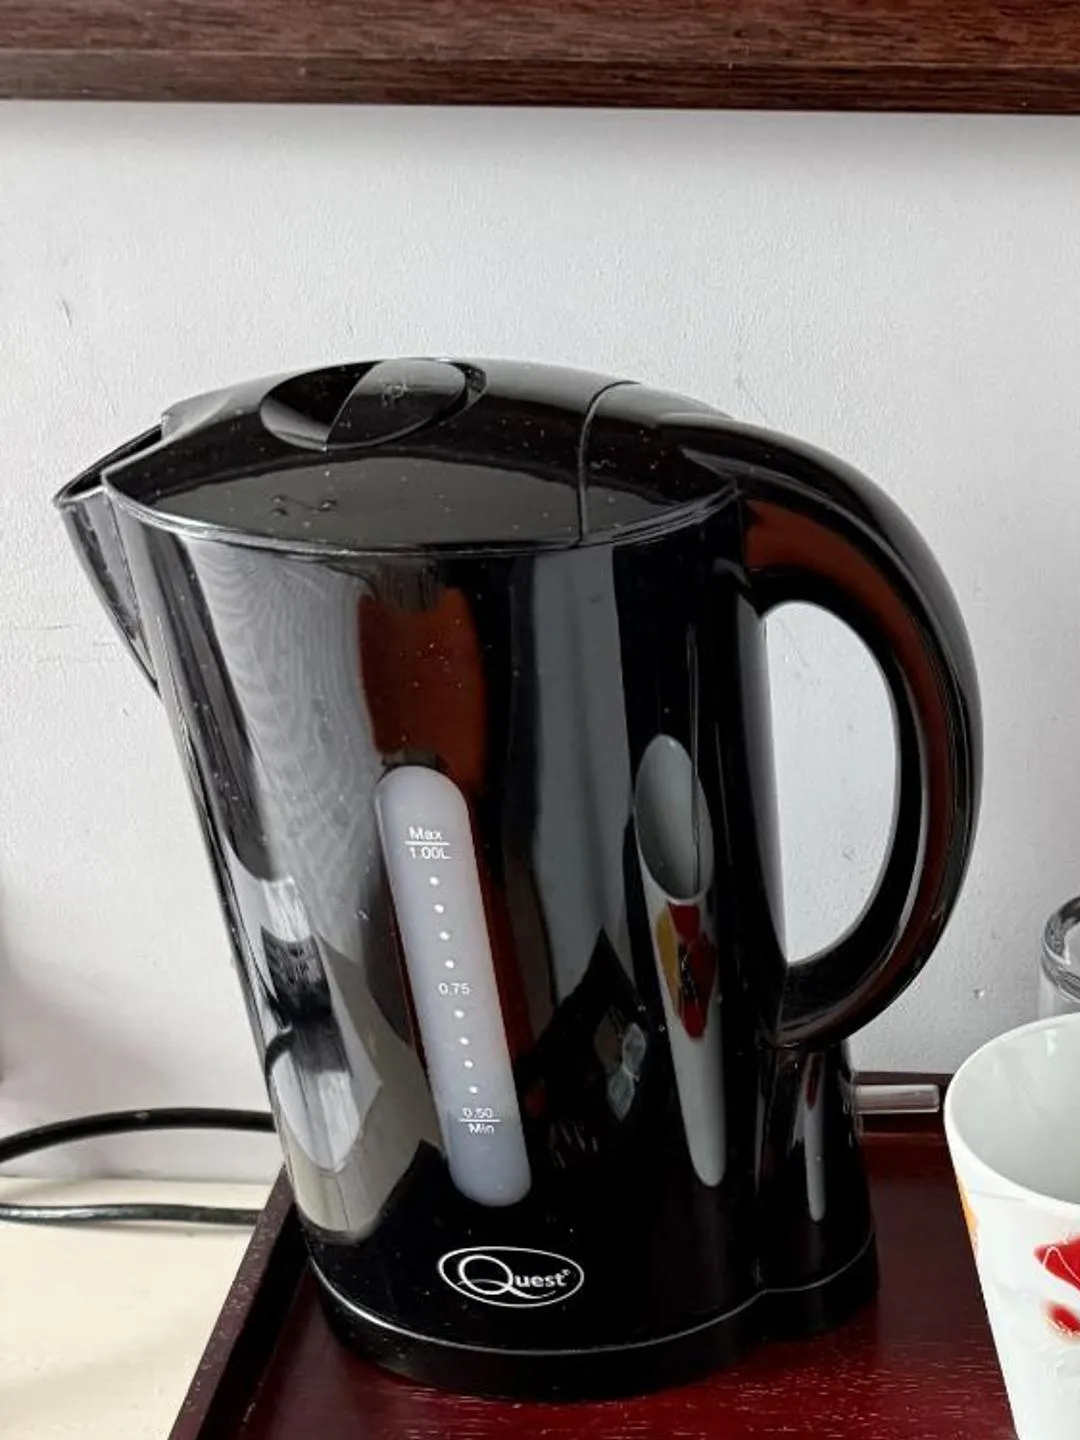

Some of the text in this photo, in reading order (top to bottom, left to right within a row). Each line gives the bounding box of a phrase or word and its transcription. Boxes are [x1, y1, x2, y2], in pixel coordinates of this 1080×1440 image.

[409, 827, 442, 841] Max
[409, 846, 451, 860] 1.00L
[438, 982, 470, 996] 0.75
[461, 1108, 494, 1119] 0.50
[467, 1122, 496, 1135] Min
[456, 1253, 566, 1300] Quest
